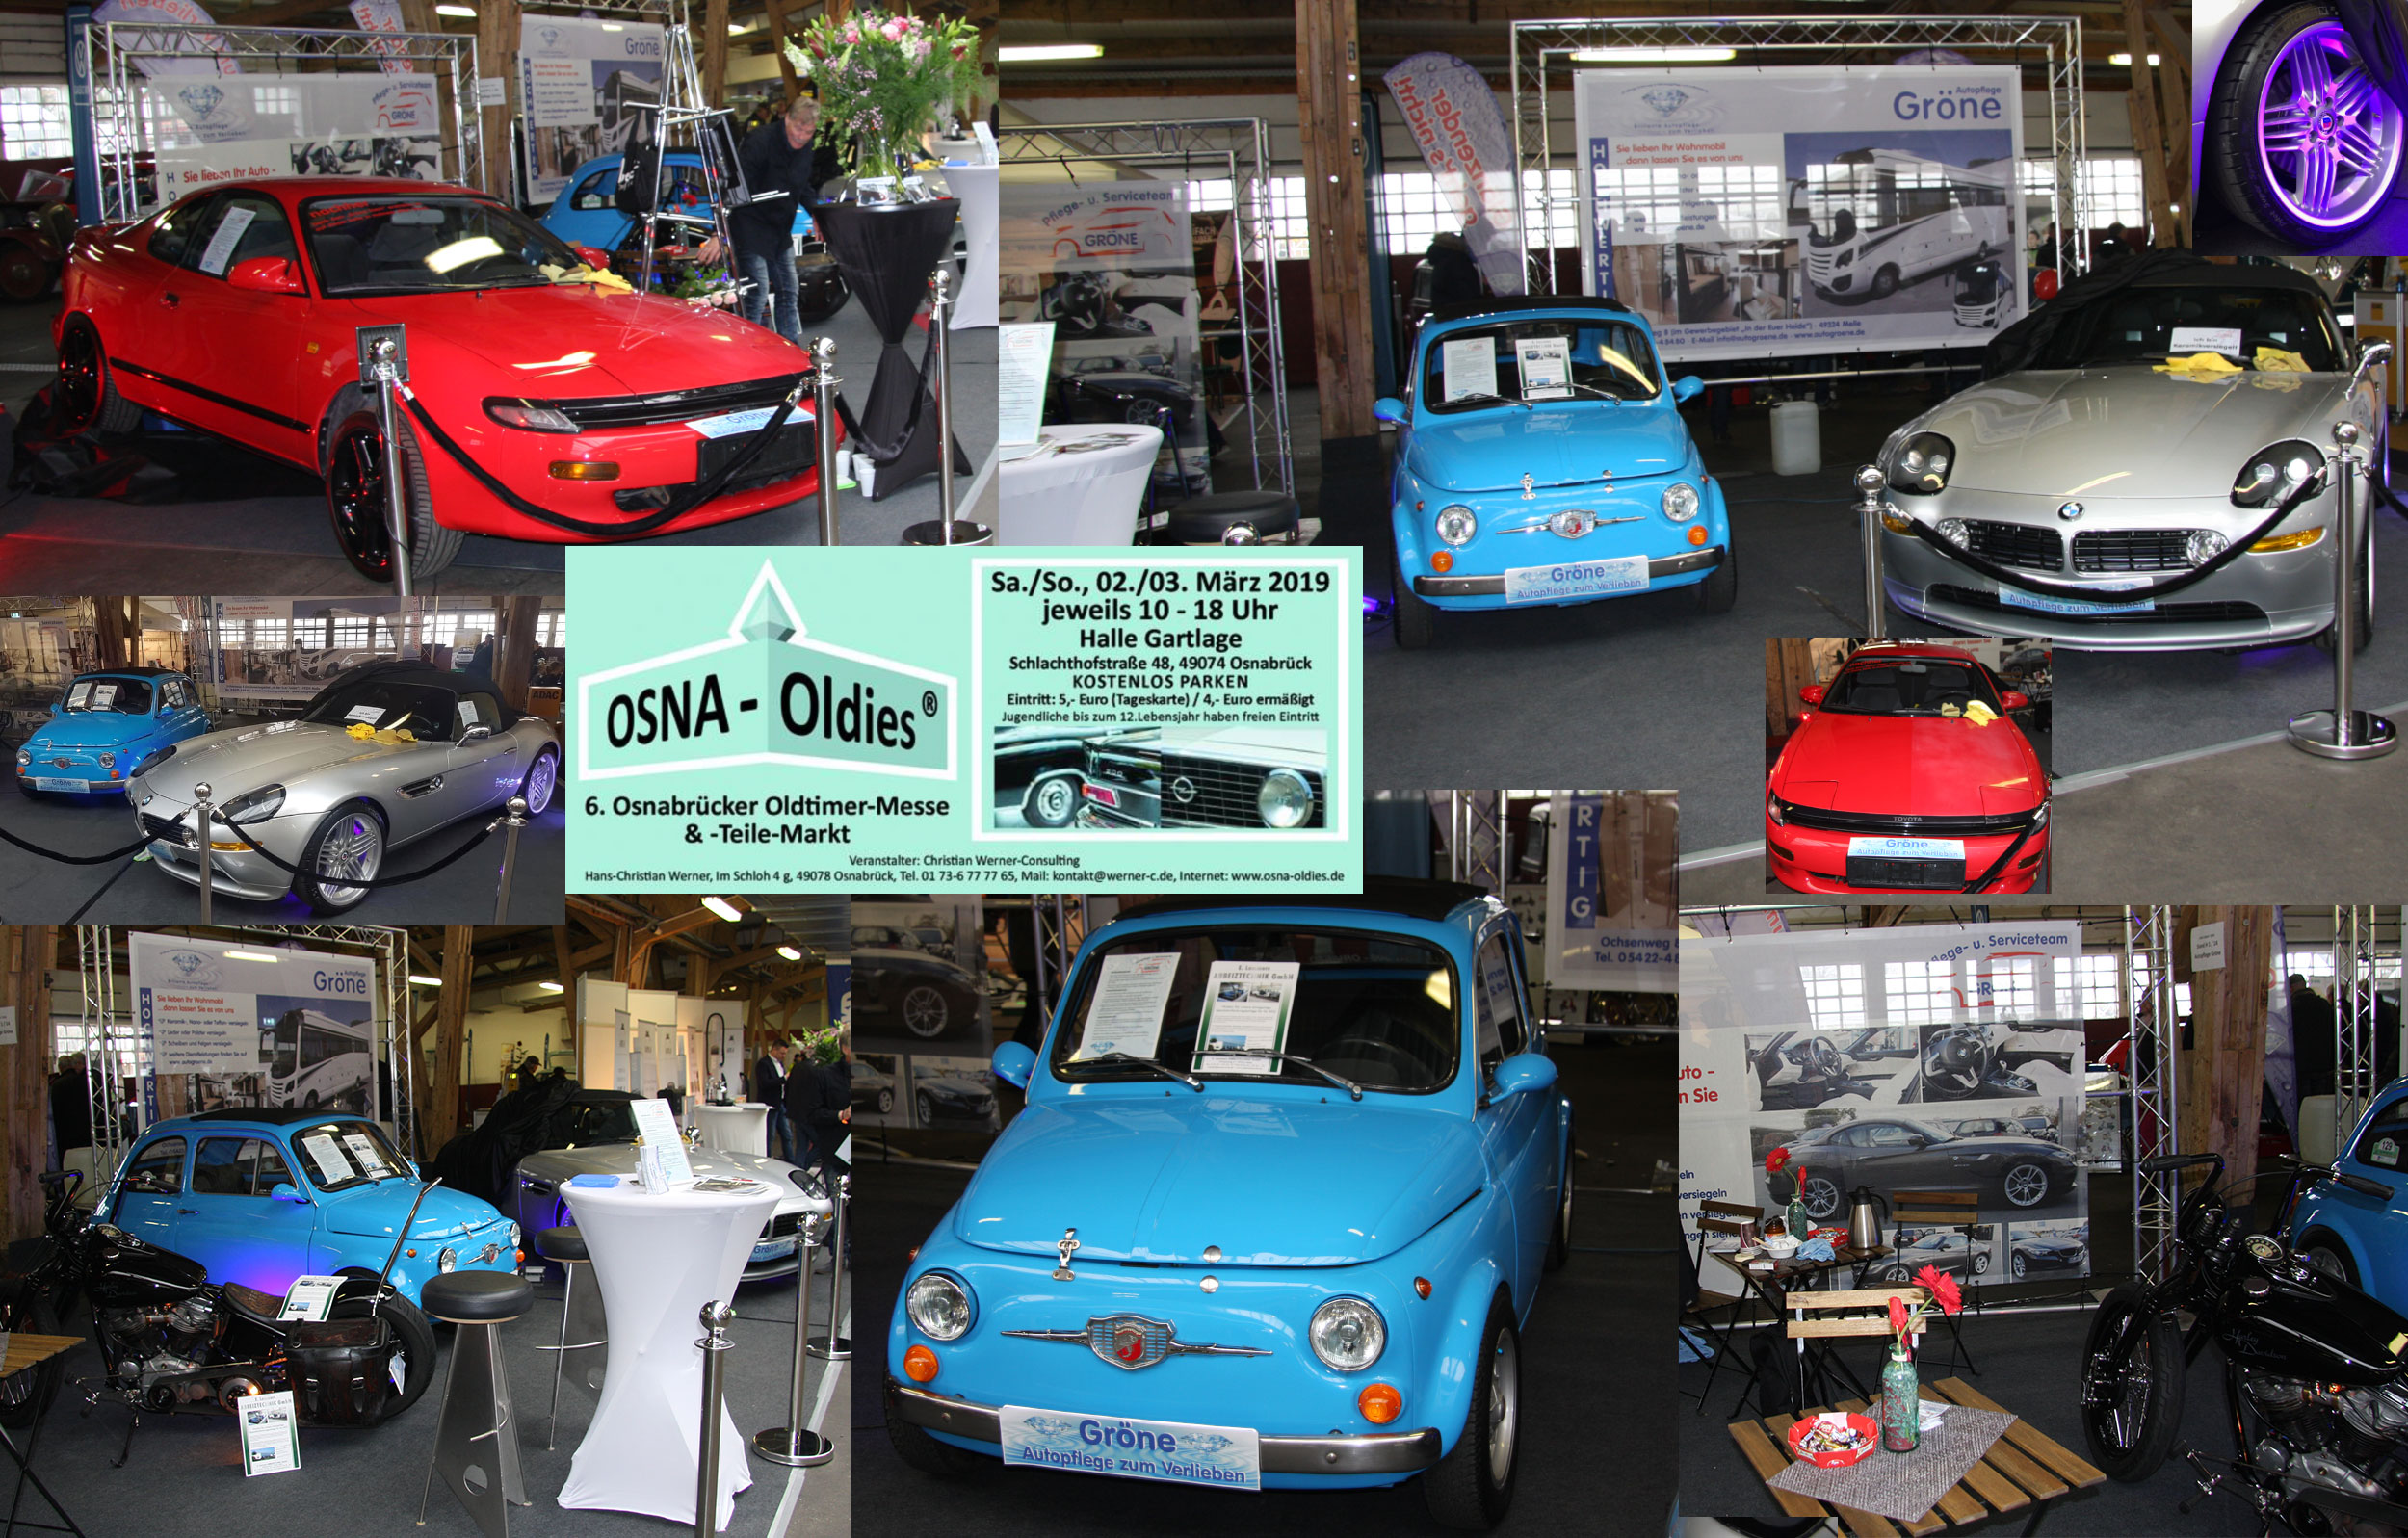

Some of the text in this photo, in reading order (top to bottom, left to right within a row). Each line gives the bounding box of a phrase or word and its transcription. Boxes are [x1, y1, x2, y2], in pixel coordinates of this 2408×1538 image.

[1955, 85, 2002, 95] Autopflege
[1894, 90, 2002, 120] Gröne
[1616, 142, 1726, 153] Sie lieben Ihr Wohnmobil
[1651, 154, 1679, 164] lassen
[1681, 154, 1695, 164] Sie
[183, 170, 199, 184] Sie
[201, 169, 231, 183] lieben
[233, 168, 246, 179] Ihr
[248, 166, 270, 177] Auto
[1041, 199, 1084, 227] Pflege-
[1088, 196, 1100, 205] u.
[1085, 230, 1138, 247] GRÖNE
[1552, 564, 1606, 583] Gröne
[1517, 579, 1642, 599] Autopflege zum Verlieben
[2009, 593, 2064, 612] Autopflege
[532, 691, 559, 700] ADAC
[1885, 837, 1928, 848] Gröne
[1856, 848, 1900, 857] Autopflege
[1600, 935, 1671, 951] Ochsenweg
[1973, 933, 2068, 950] u. Serviceteam
[1594, 951, 1613, 964] Tel.
[313, 970, 366, 994] Gröne
[194, 996, 224, 1004] Wohnmobil
[1693, 1086, 1719, 1103] Sie
[1079, 1419, 1178, 1453] Gröne
[1022, 1446, 1246, 1483] Autopflege zum Verlieben
